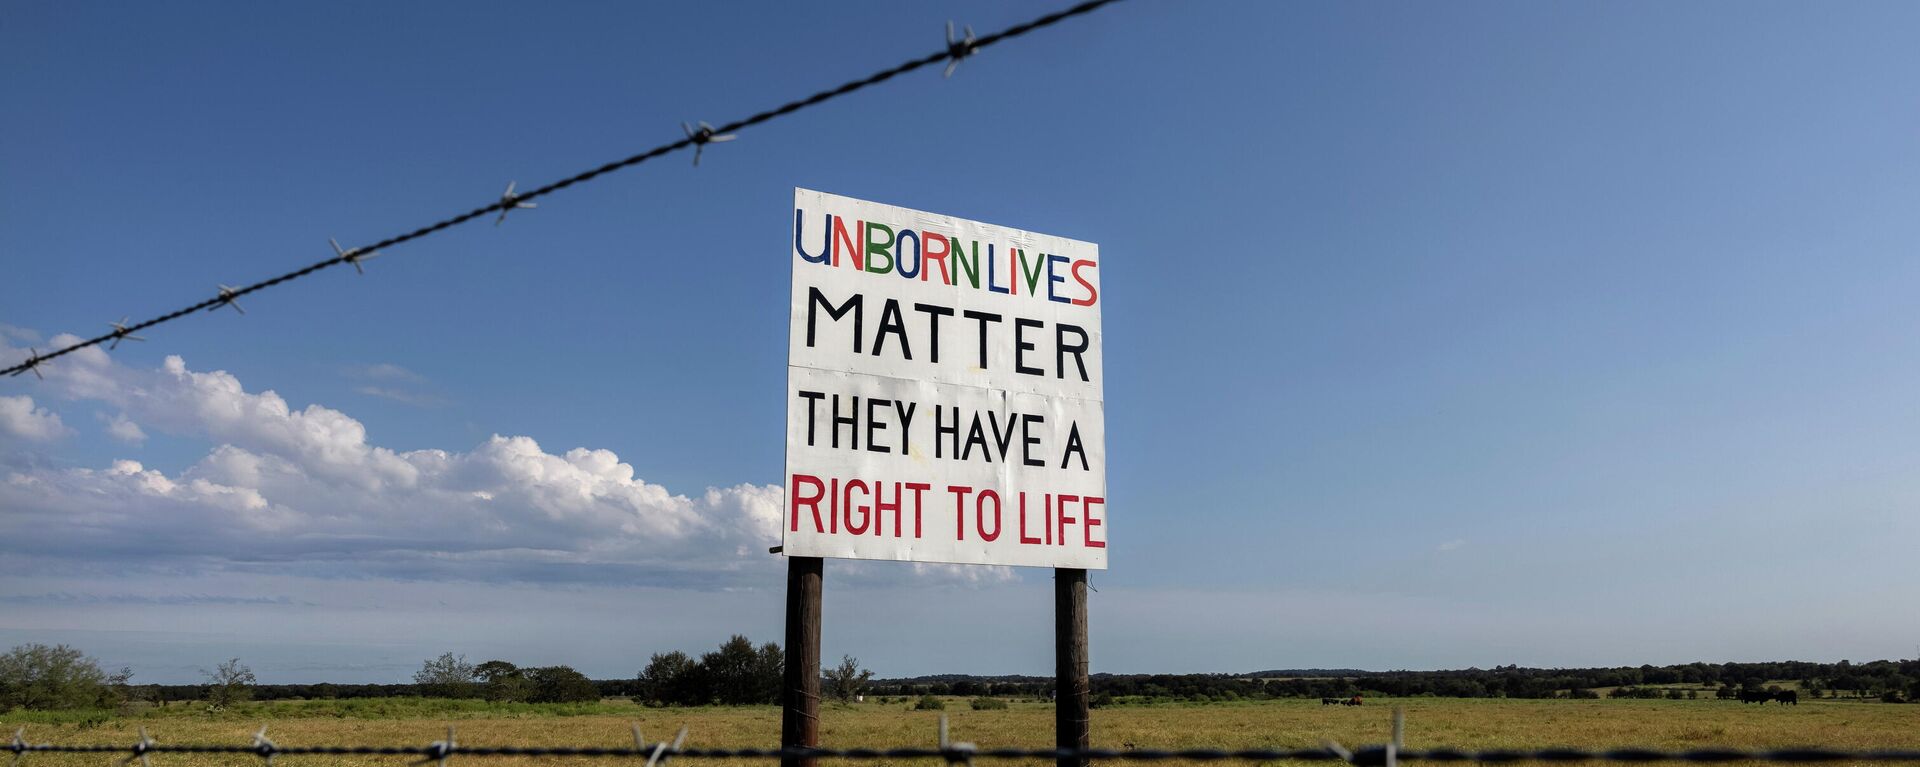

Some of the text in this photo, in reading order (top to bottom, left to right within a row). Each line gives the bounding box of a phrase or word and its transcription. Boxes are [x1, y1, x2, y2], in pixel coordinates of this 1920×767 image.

[795, 208, 1098, 307] UNBORN LIVES
[806, 286, 1090, 382] MATTER
[798, 390, 1090, 472] THEY HAVE A
[790, 473, 1106, 549] RIGHT TO LIFE
